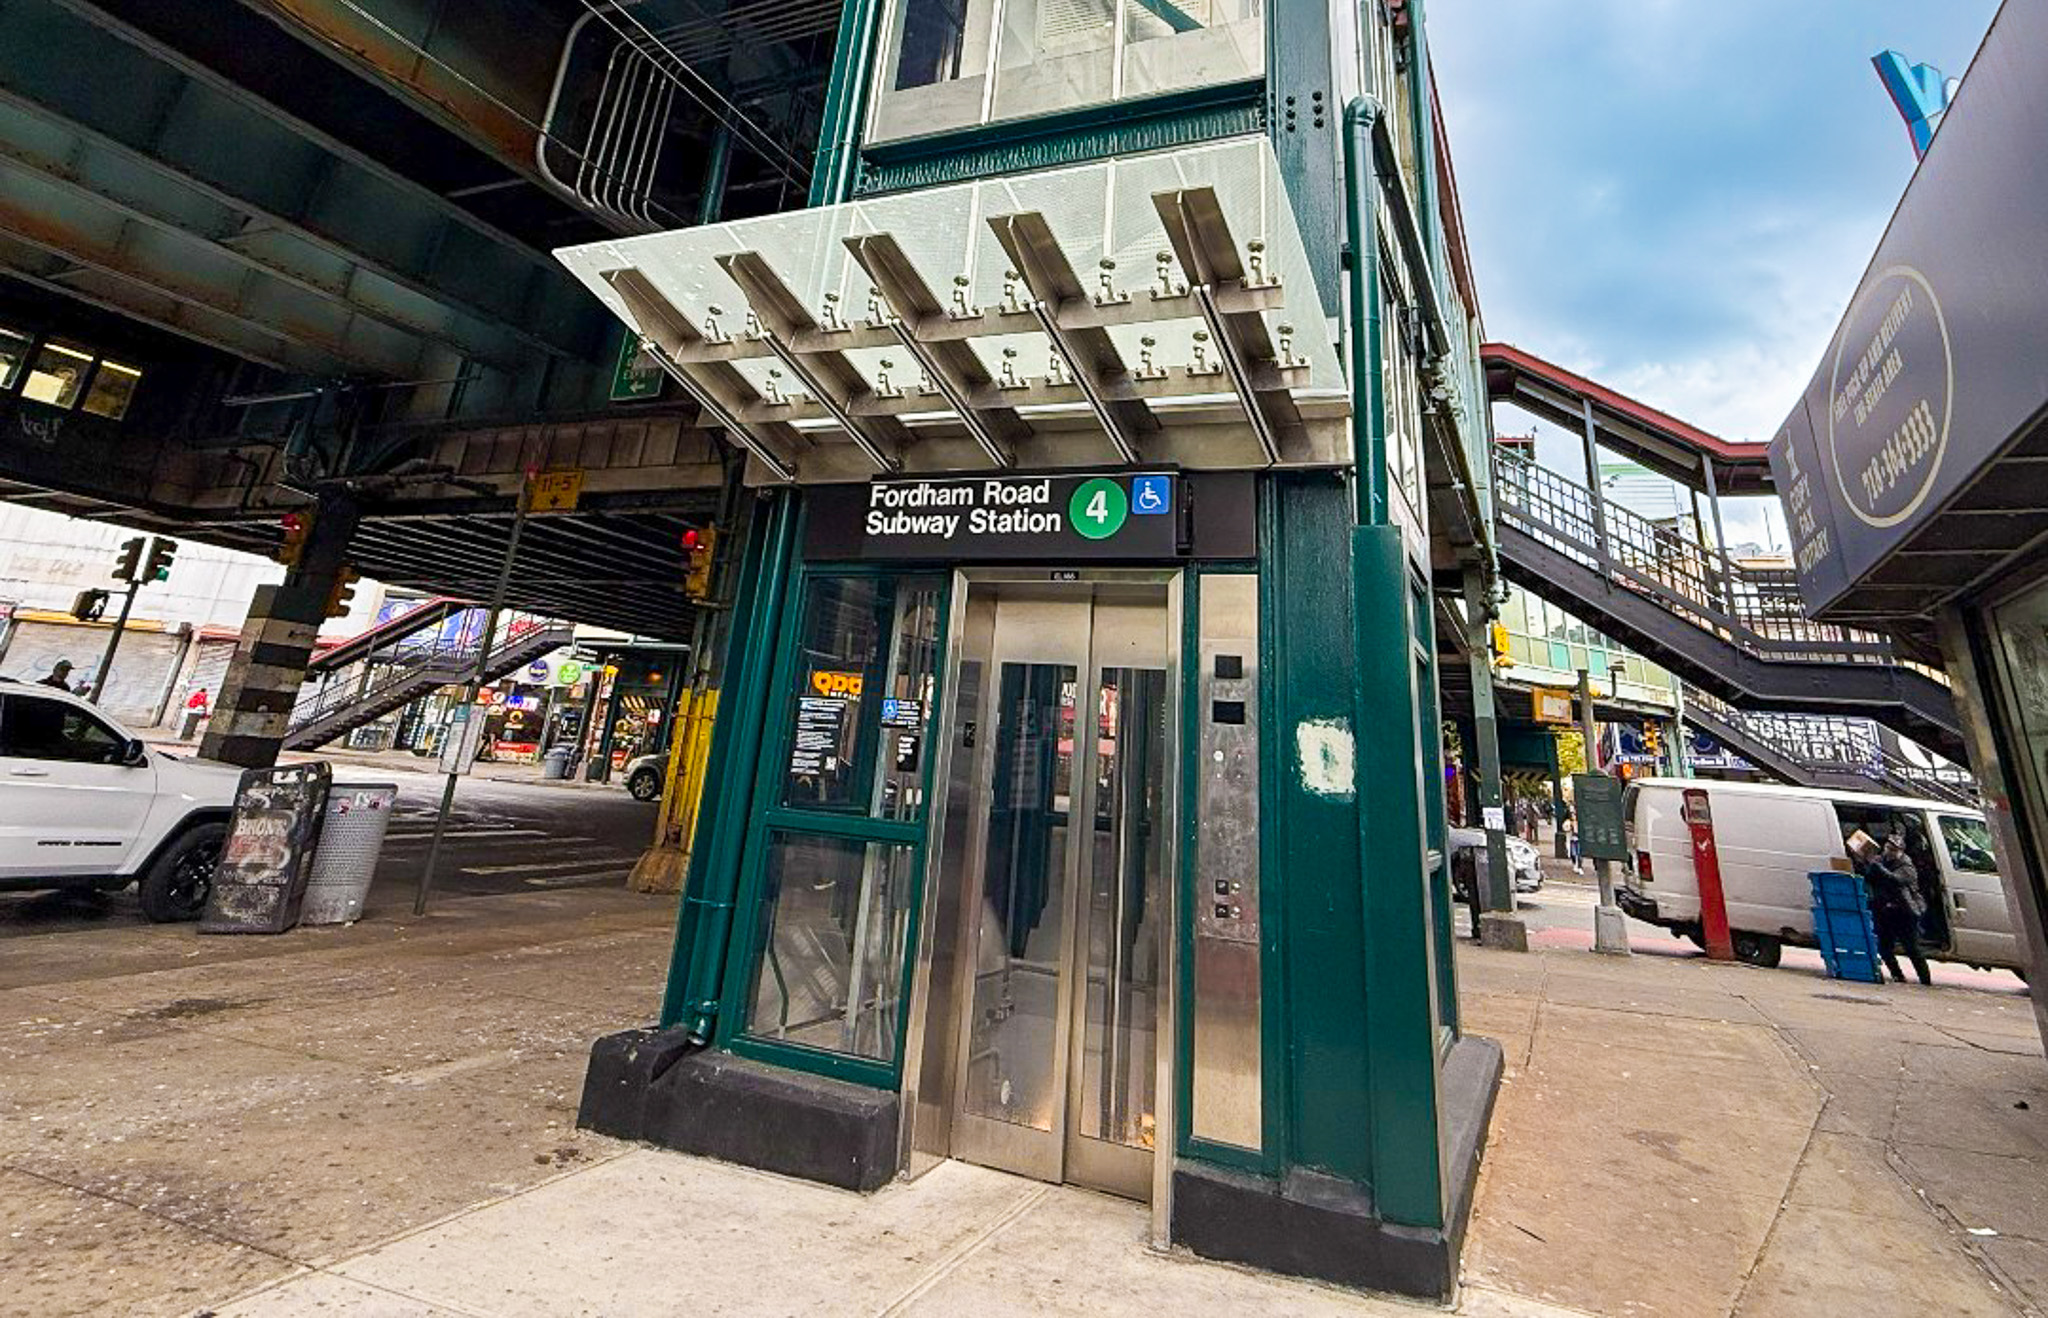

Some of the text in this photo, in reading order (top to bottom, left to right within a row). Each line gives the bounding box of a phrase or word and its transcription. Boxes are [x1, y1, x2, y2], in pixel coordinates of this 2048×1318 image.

[869, 479, 1108, 524] Fordham Road 4
[865, 507, 1062, 539] Subway Station
